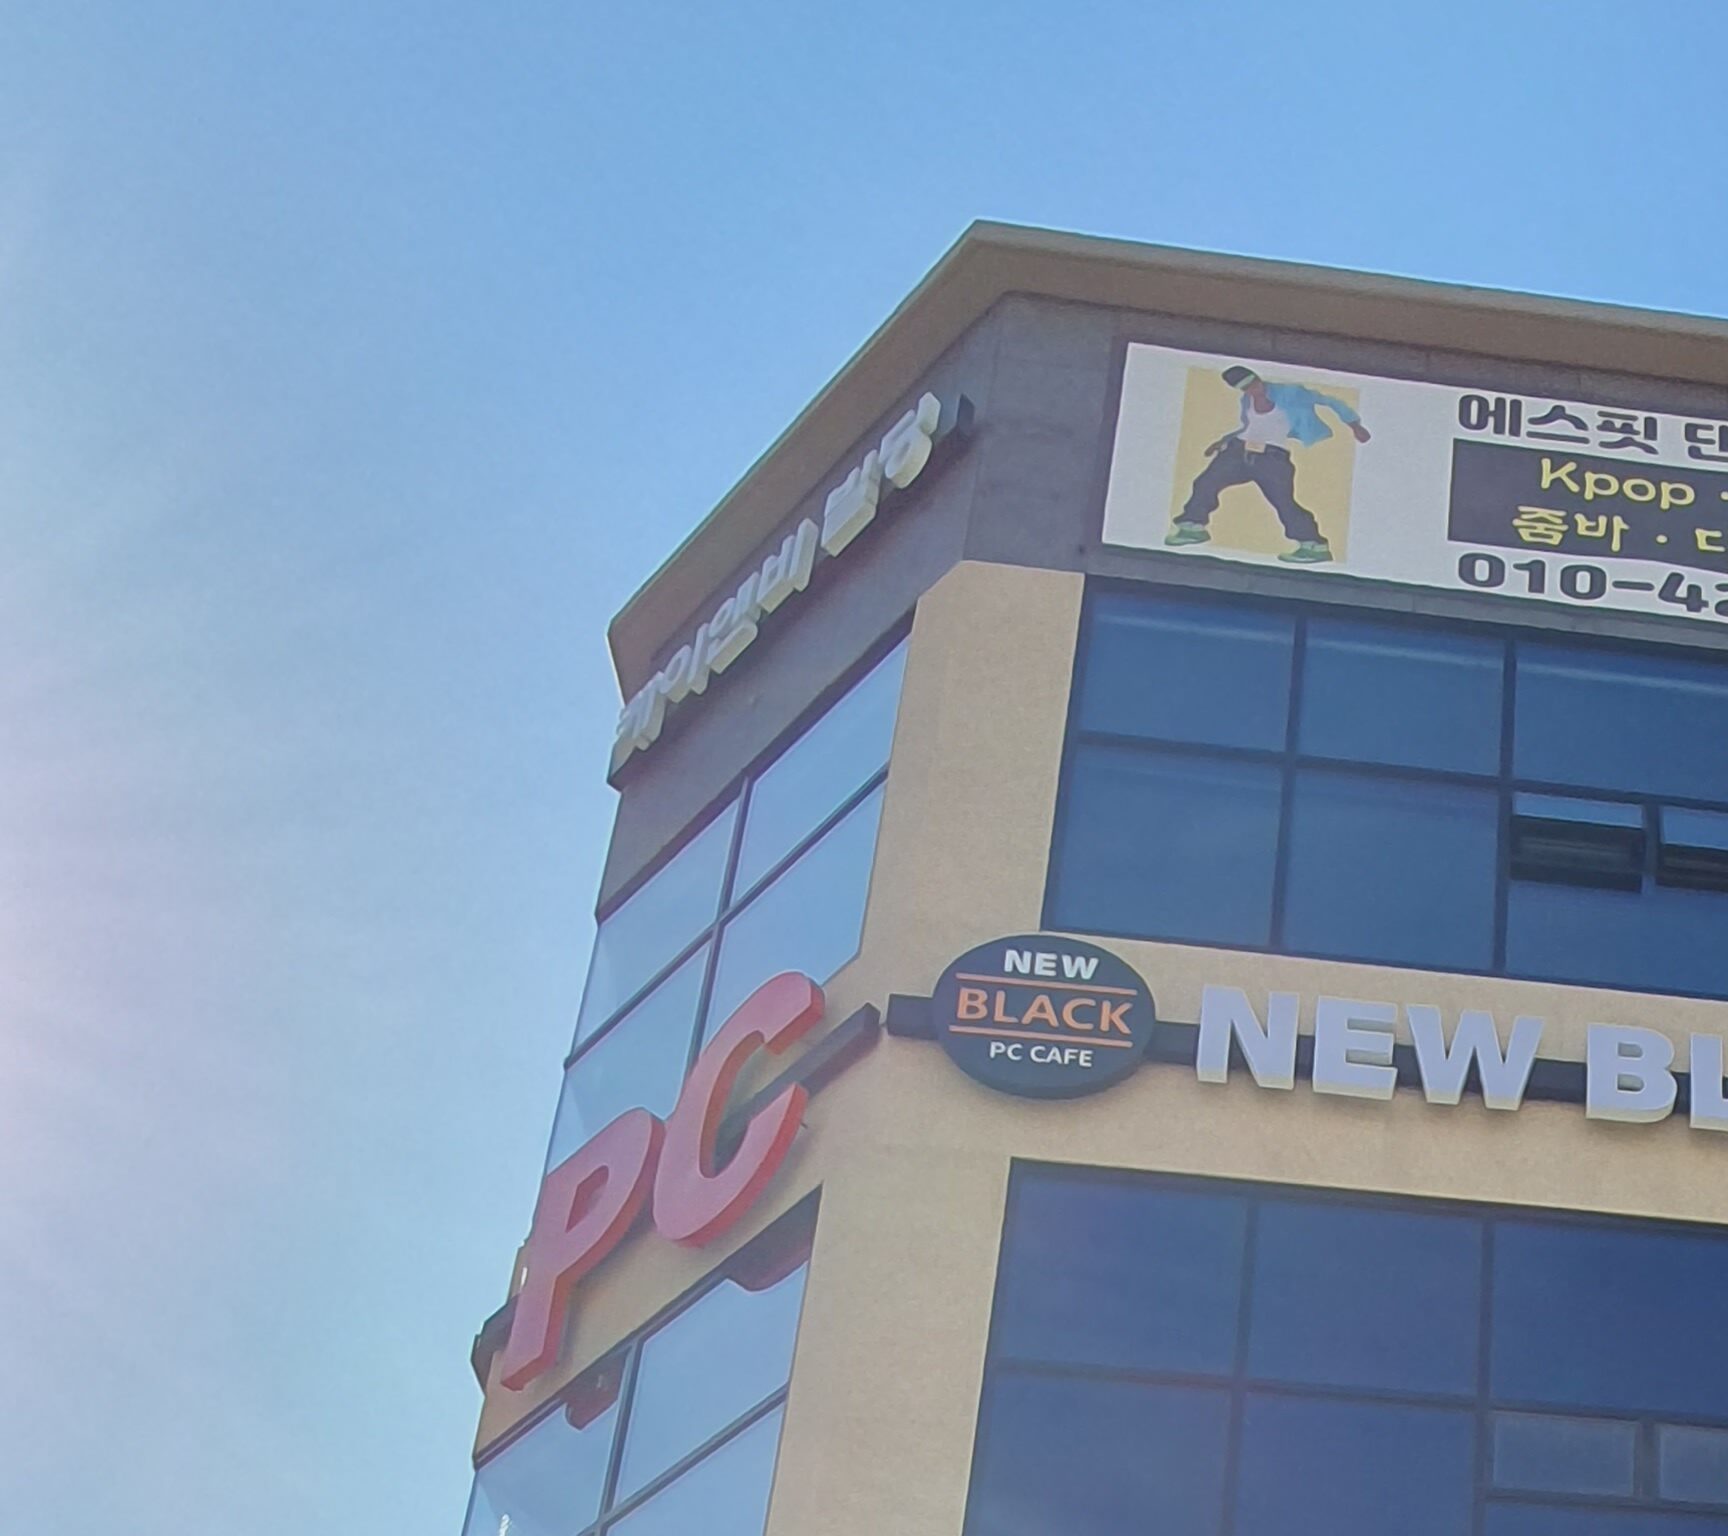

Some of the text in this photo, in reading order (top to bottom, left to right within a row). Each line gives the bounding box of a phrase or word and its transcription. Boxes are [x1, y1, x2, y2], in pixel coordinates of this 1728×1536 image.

[1458, 393, 1659, 455] 에스핏
[1540, 457, 1694, 509] Kpop
[1512, 504, 1630, 553] 줌바
[1003, 949, 1098, 980] NEW
[956, 987, 1132, 1035] BLACK
[989, 1041, 1093, 1067] PC CAFE
[1196, 983, 1545, 1111] NEW
[500, 970, 825, 1391] PC
